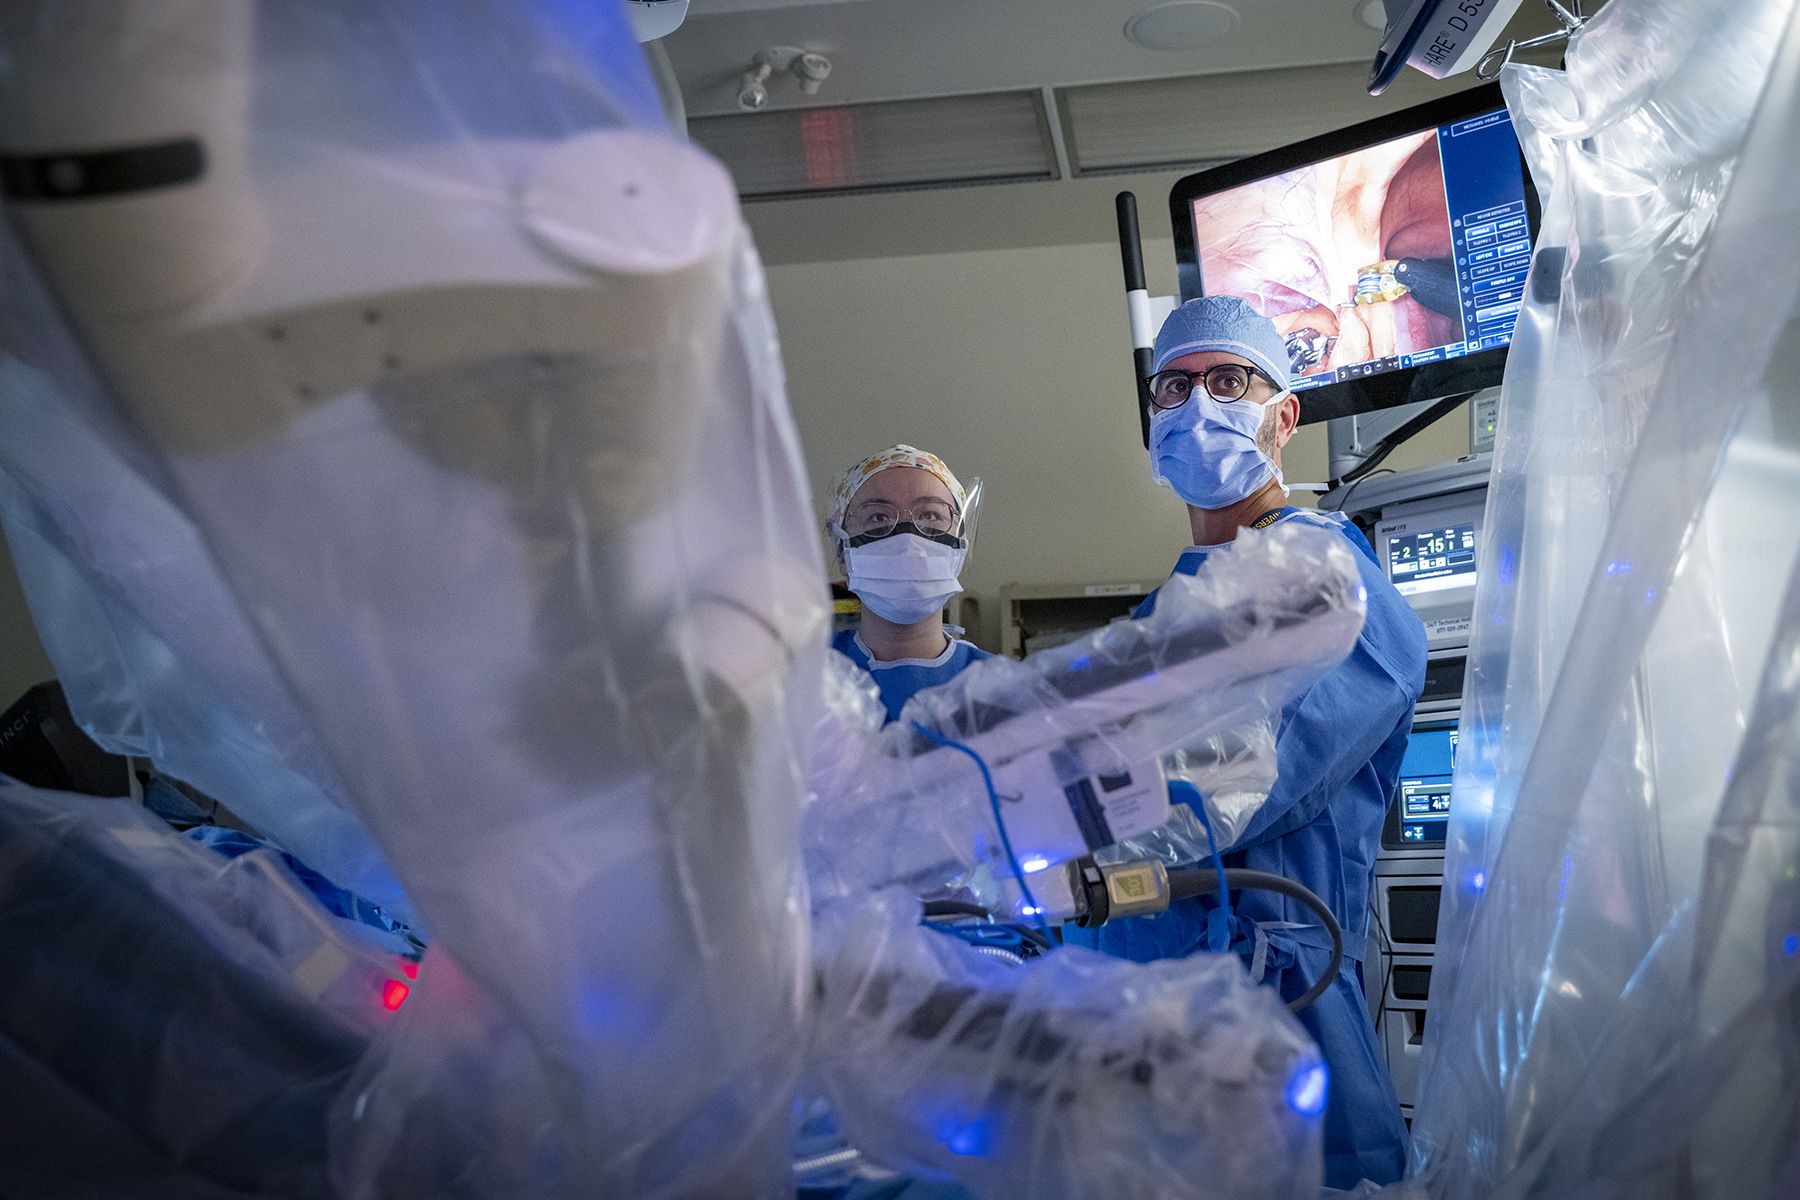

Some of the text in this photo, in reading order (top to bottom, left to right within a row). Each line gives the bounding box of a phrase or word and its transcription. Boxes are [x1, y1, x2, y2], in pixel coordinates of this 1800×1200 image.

[1447, 16, 1469, 32] D
[1402, 546, 1411, 558] 2
[1427, 537, 1444, 554] 15
